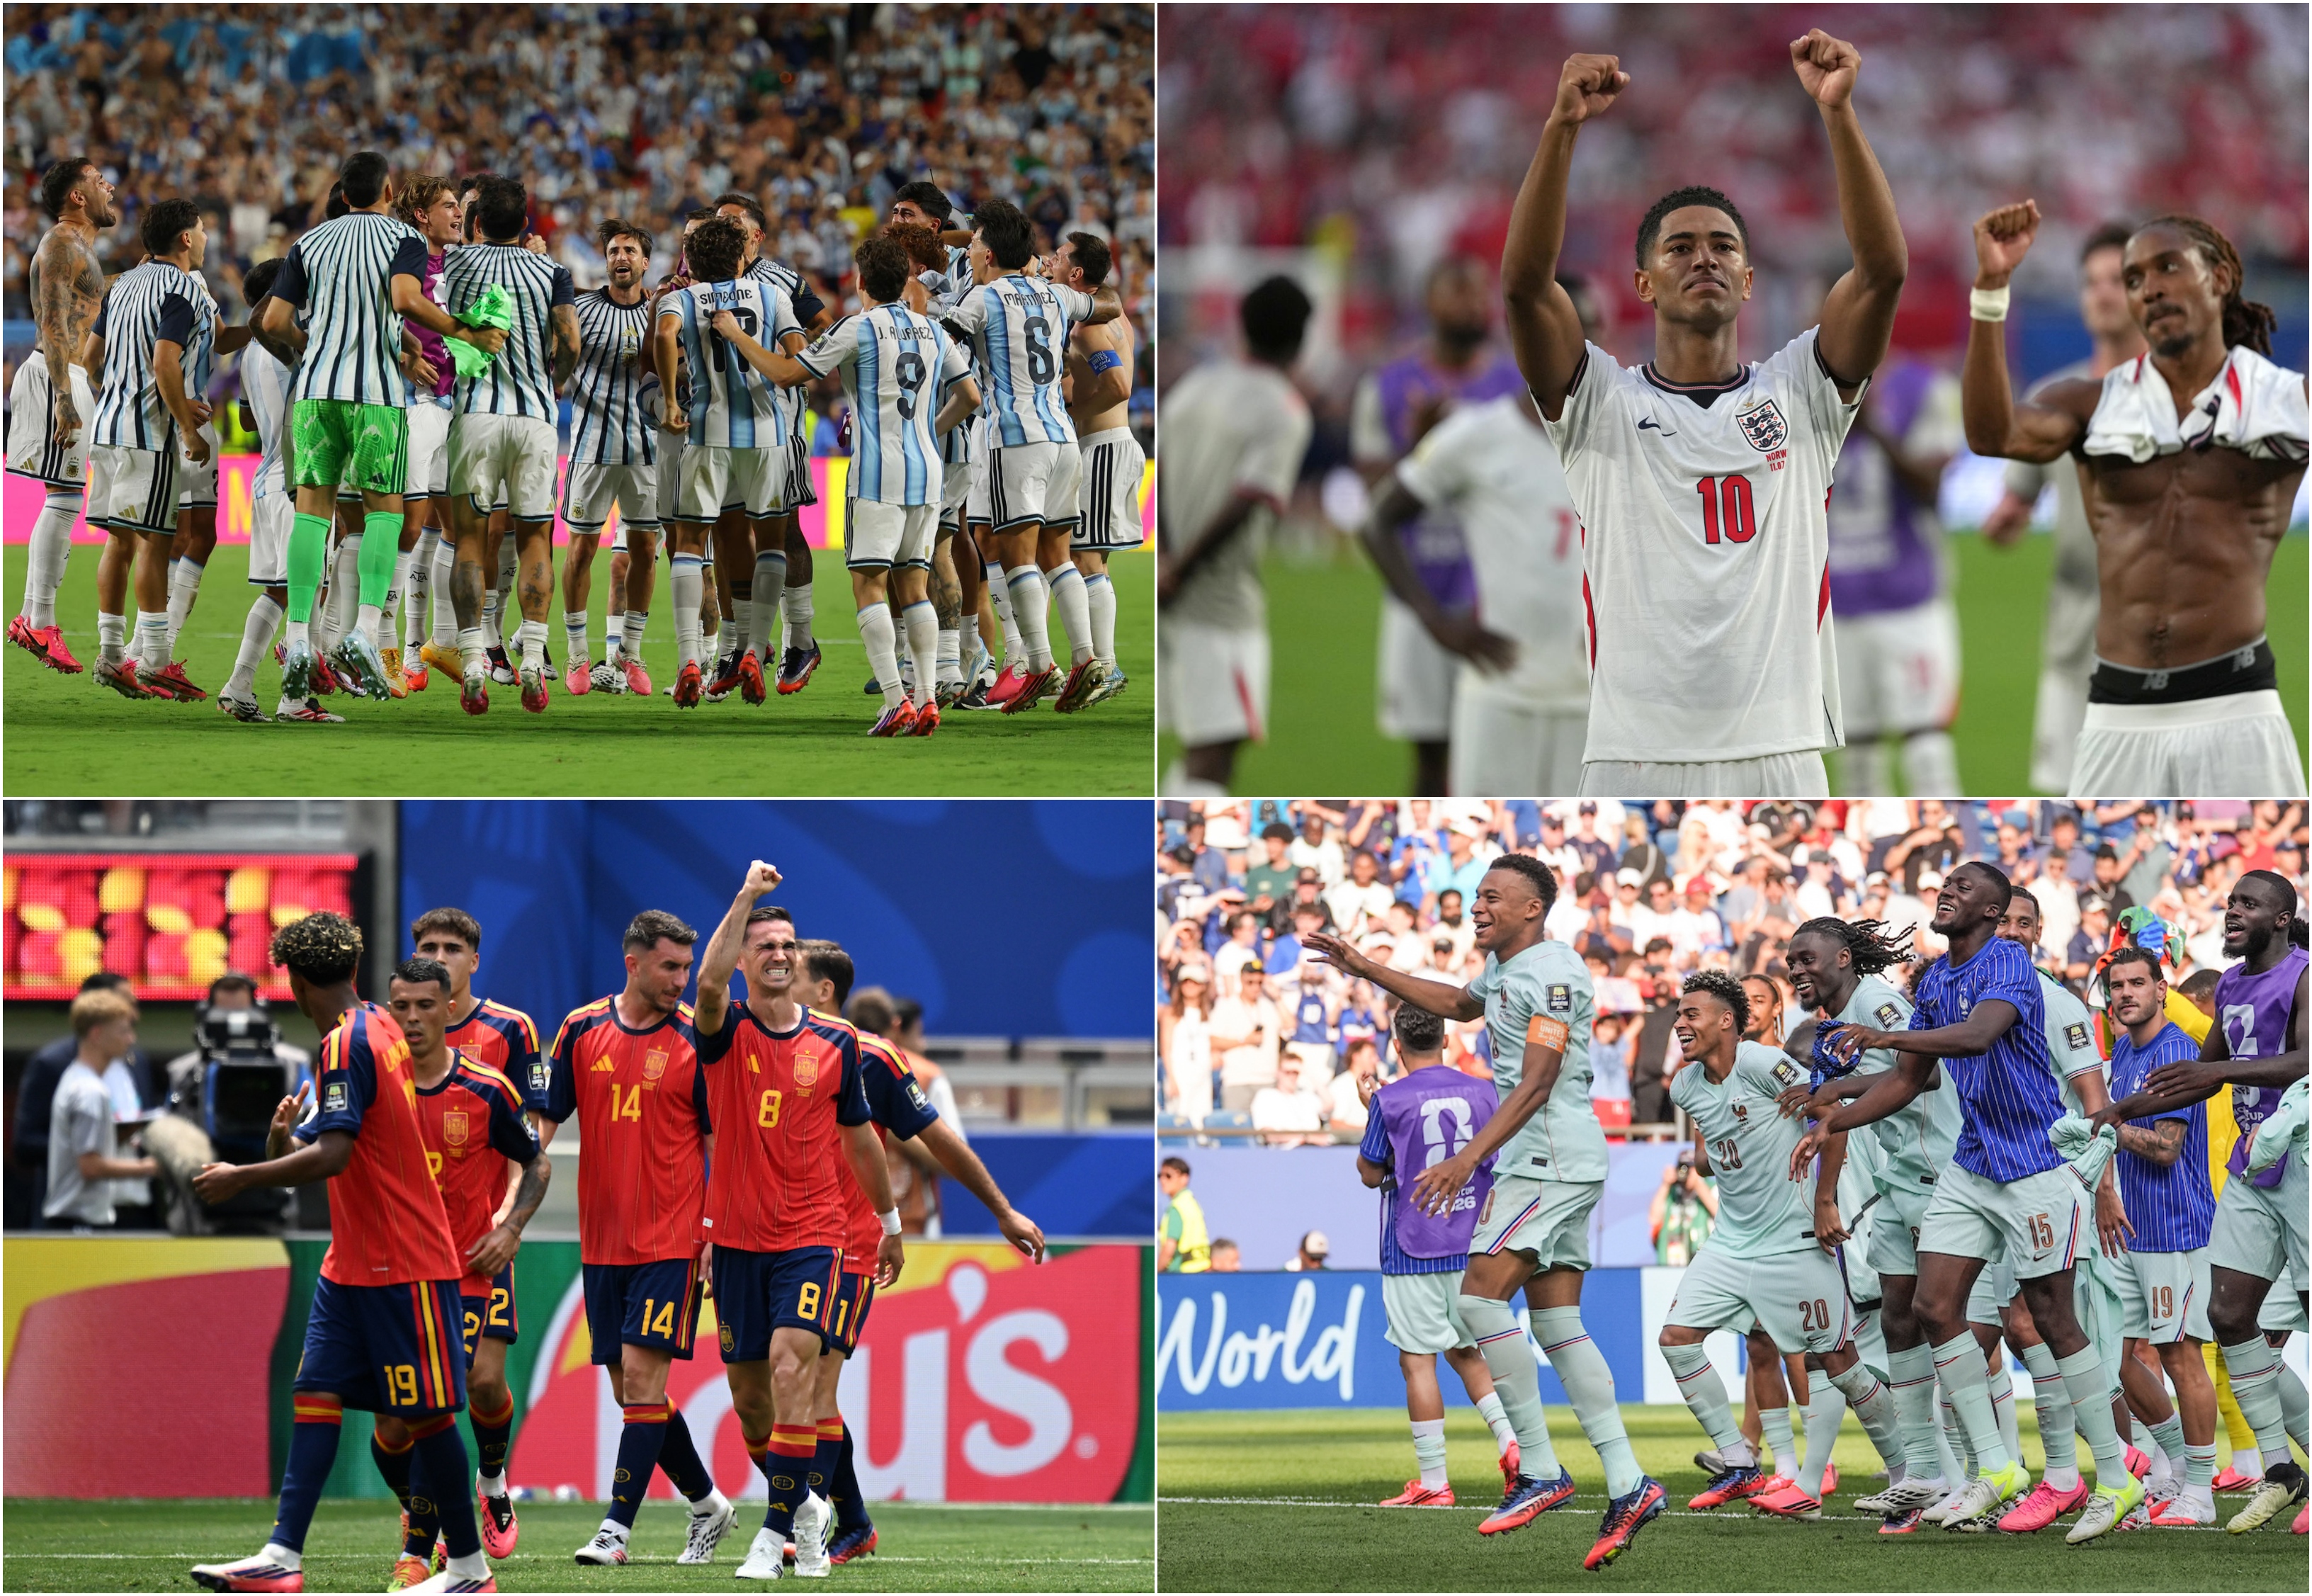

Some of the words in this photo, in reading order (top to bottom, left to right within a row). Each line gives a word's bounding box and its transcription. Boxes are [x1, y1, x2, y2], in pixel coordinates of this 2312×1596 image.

[700, 289, 752, 305] SIMEONE
[1004, 291, 1055, 307] MARTINEZ
[879, 327, 887, 340] J.
[890, 327, 934, 341] ALVAREZ
[1024, 316, 1055, 385] 6
[895, 352, 926, 421] 9
[1766, 448, 1789, 463] NORW
[1696, 474, 1757, 544] 10
[386, 590, 398, 601] FA
[991, 594, 1002, 604] FA
[1540, 1024, 1564, 1038] UNITES
[611, 1083, 641, 1123] 14
[758, 1089, 782, 1128] 8
[1717, 1138, 1742, 1171] 20
[1461, 1186, 1475, 1196] CUP
[2028, 1212, 2053, 1250] 15
[797, 1281, 821, 1320] 8
[1798, 1298, 1830, 1333] 20
[2151, 1285, 2173, 1320] 19
[641, 1298, 675, 1340] 14
[1157, 1278, 1366, 1402] World
[384, 1364, 419, 1406] 19
